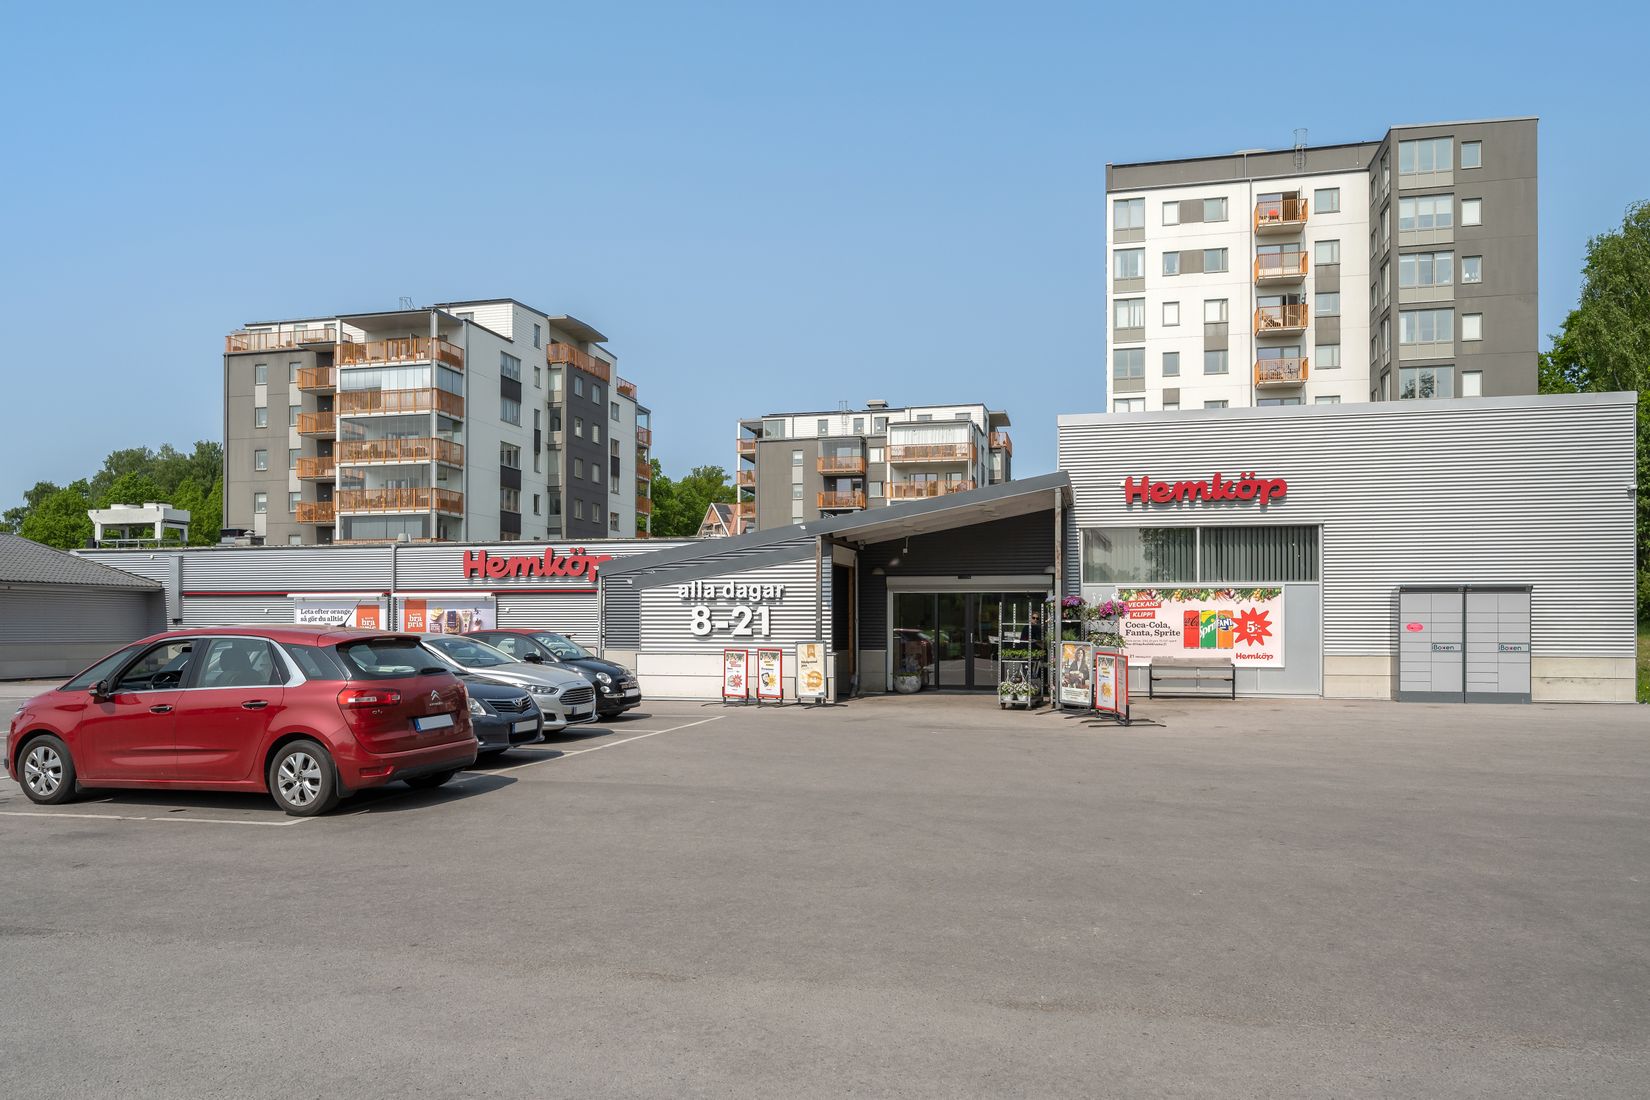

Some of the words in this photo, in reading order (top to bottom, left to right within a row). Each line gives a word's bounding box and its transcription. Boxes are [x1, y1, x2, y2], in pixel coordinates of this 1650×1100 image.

[1124, 471, 1288, 505] Hemköp
[677, 581, 716, 599] alla
[722, 581, 785, 601] dagar
[361, 618, 375, 626] bra
[407, 620, 424, 629] pris
[1125, 621, 1171, 629] Coca-Cola,
[1125, 629, 1153, 637] Fanta,
[1154, 629, 1181, 637] Sprite
[1235, 652, 1274, 661] Hemköp
